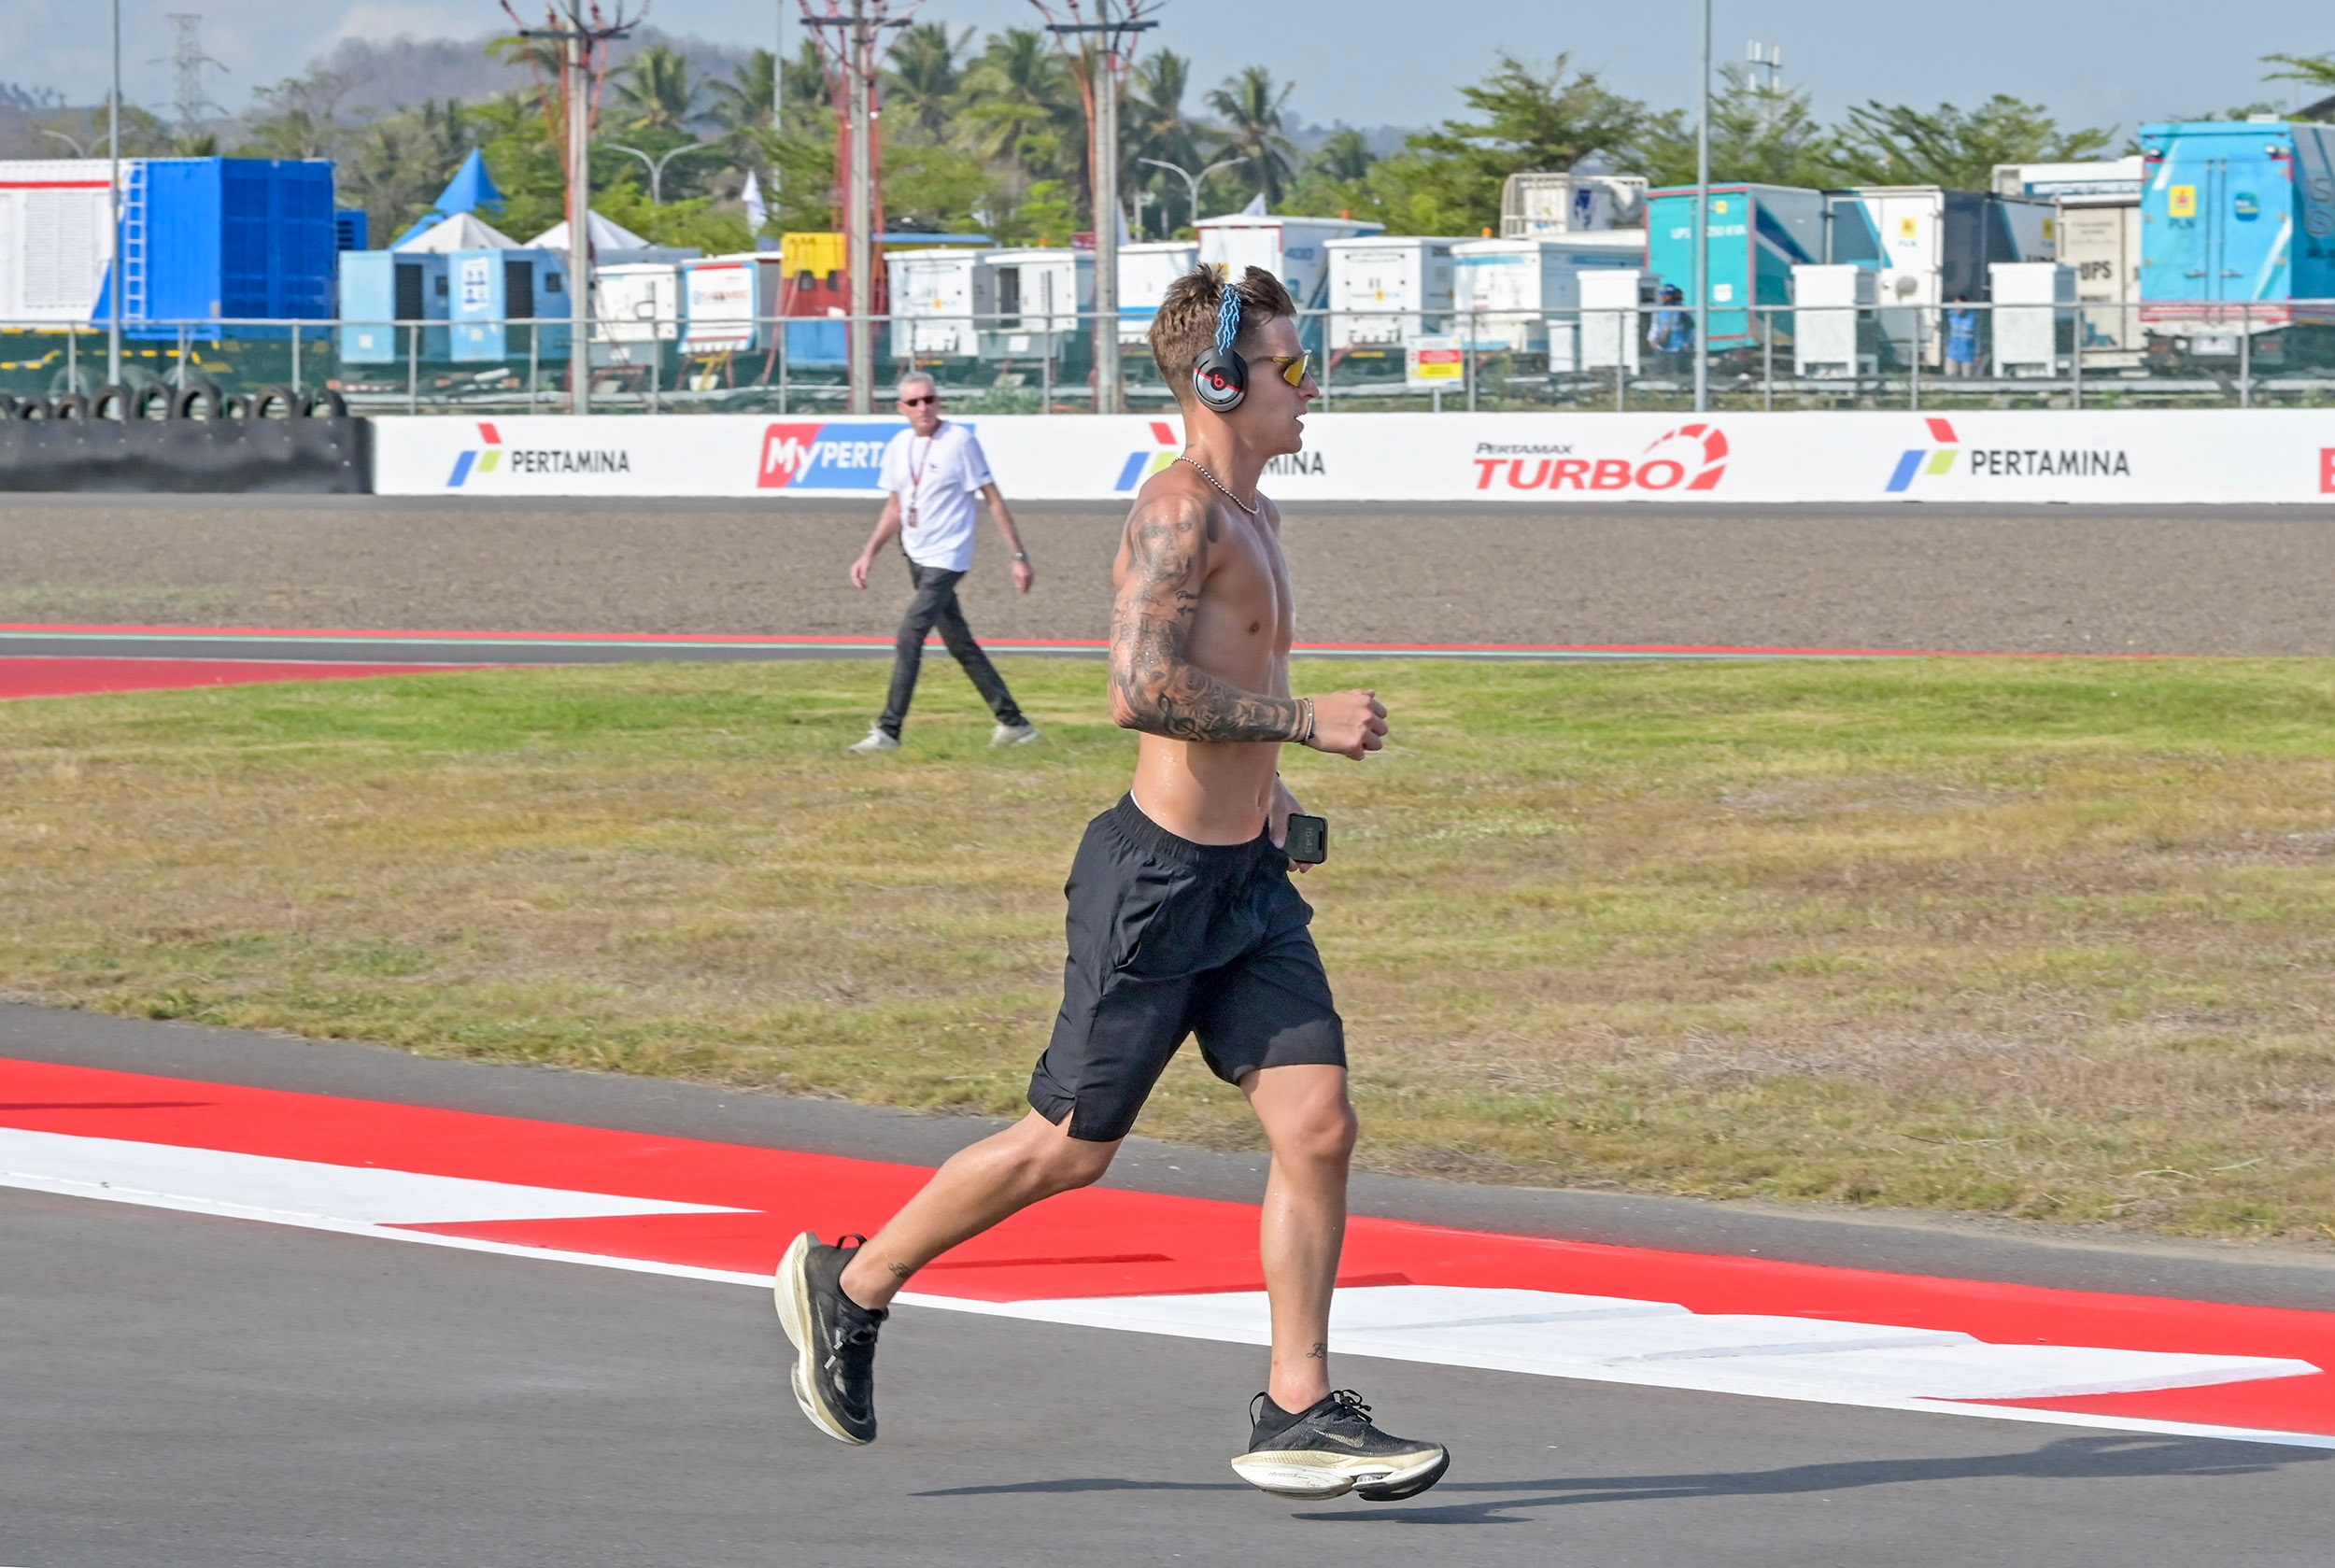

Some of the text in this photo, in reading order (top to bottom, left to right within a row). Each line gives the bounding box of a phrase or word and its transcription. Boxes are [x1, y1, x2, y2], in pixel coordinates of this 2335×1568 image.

[2081, 261, 2112, 280] UPS
[766, 436, 885, 484] MyPERT
[1476, 443, 1574, 455] PERTAMAX
[512, 450, 630, 473] PERTAMINA
[1263, 452, 1325, 474] MINA
[1972, 450, 2130, 475] PERTAMINA
[1474, 459, 1685, 490] TURBO
